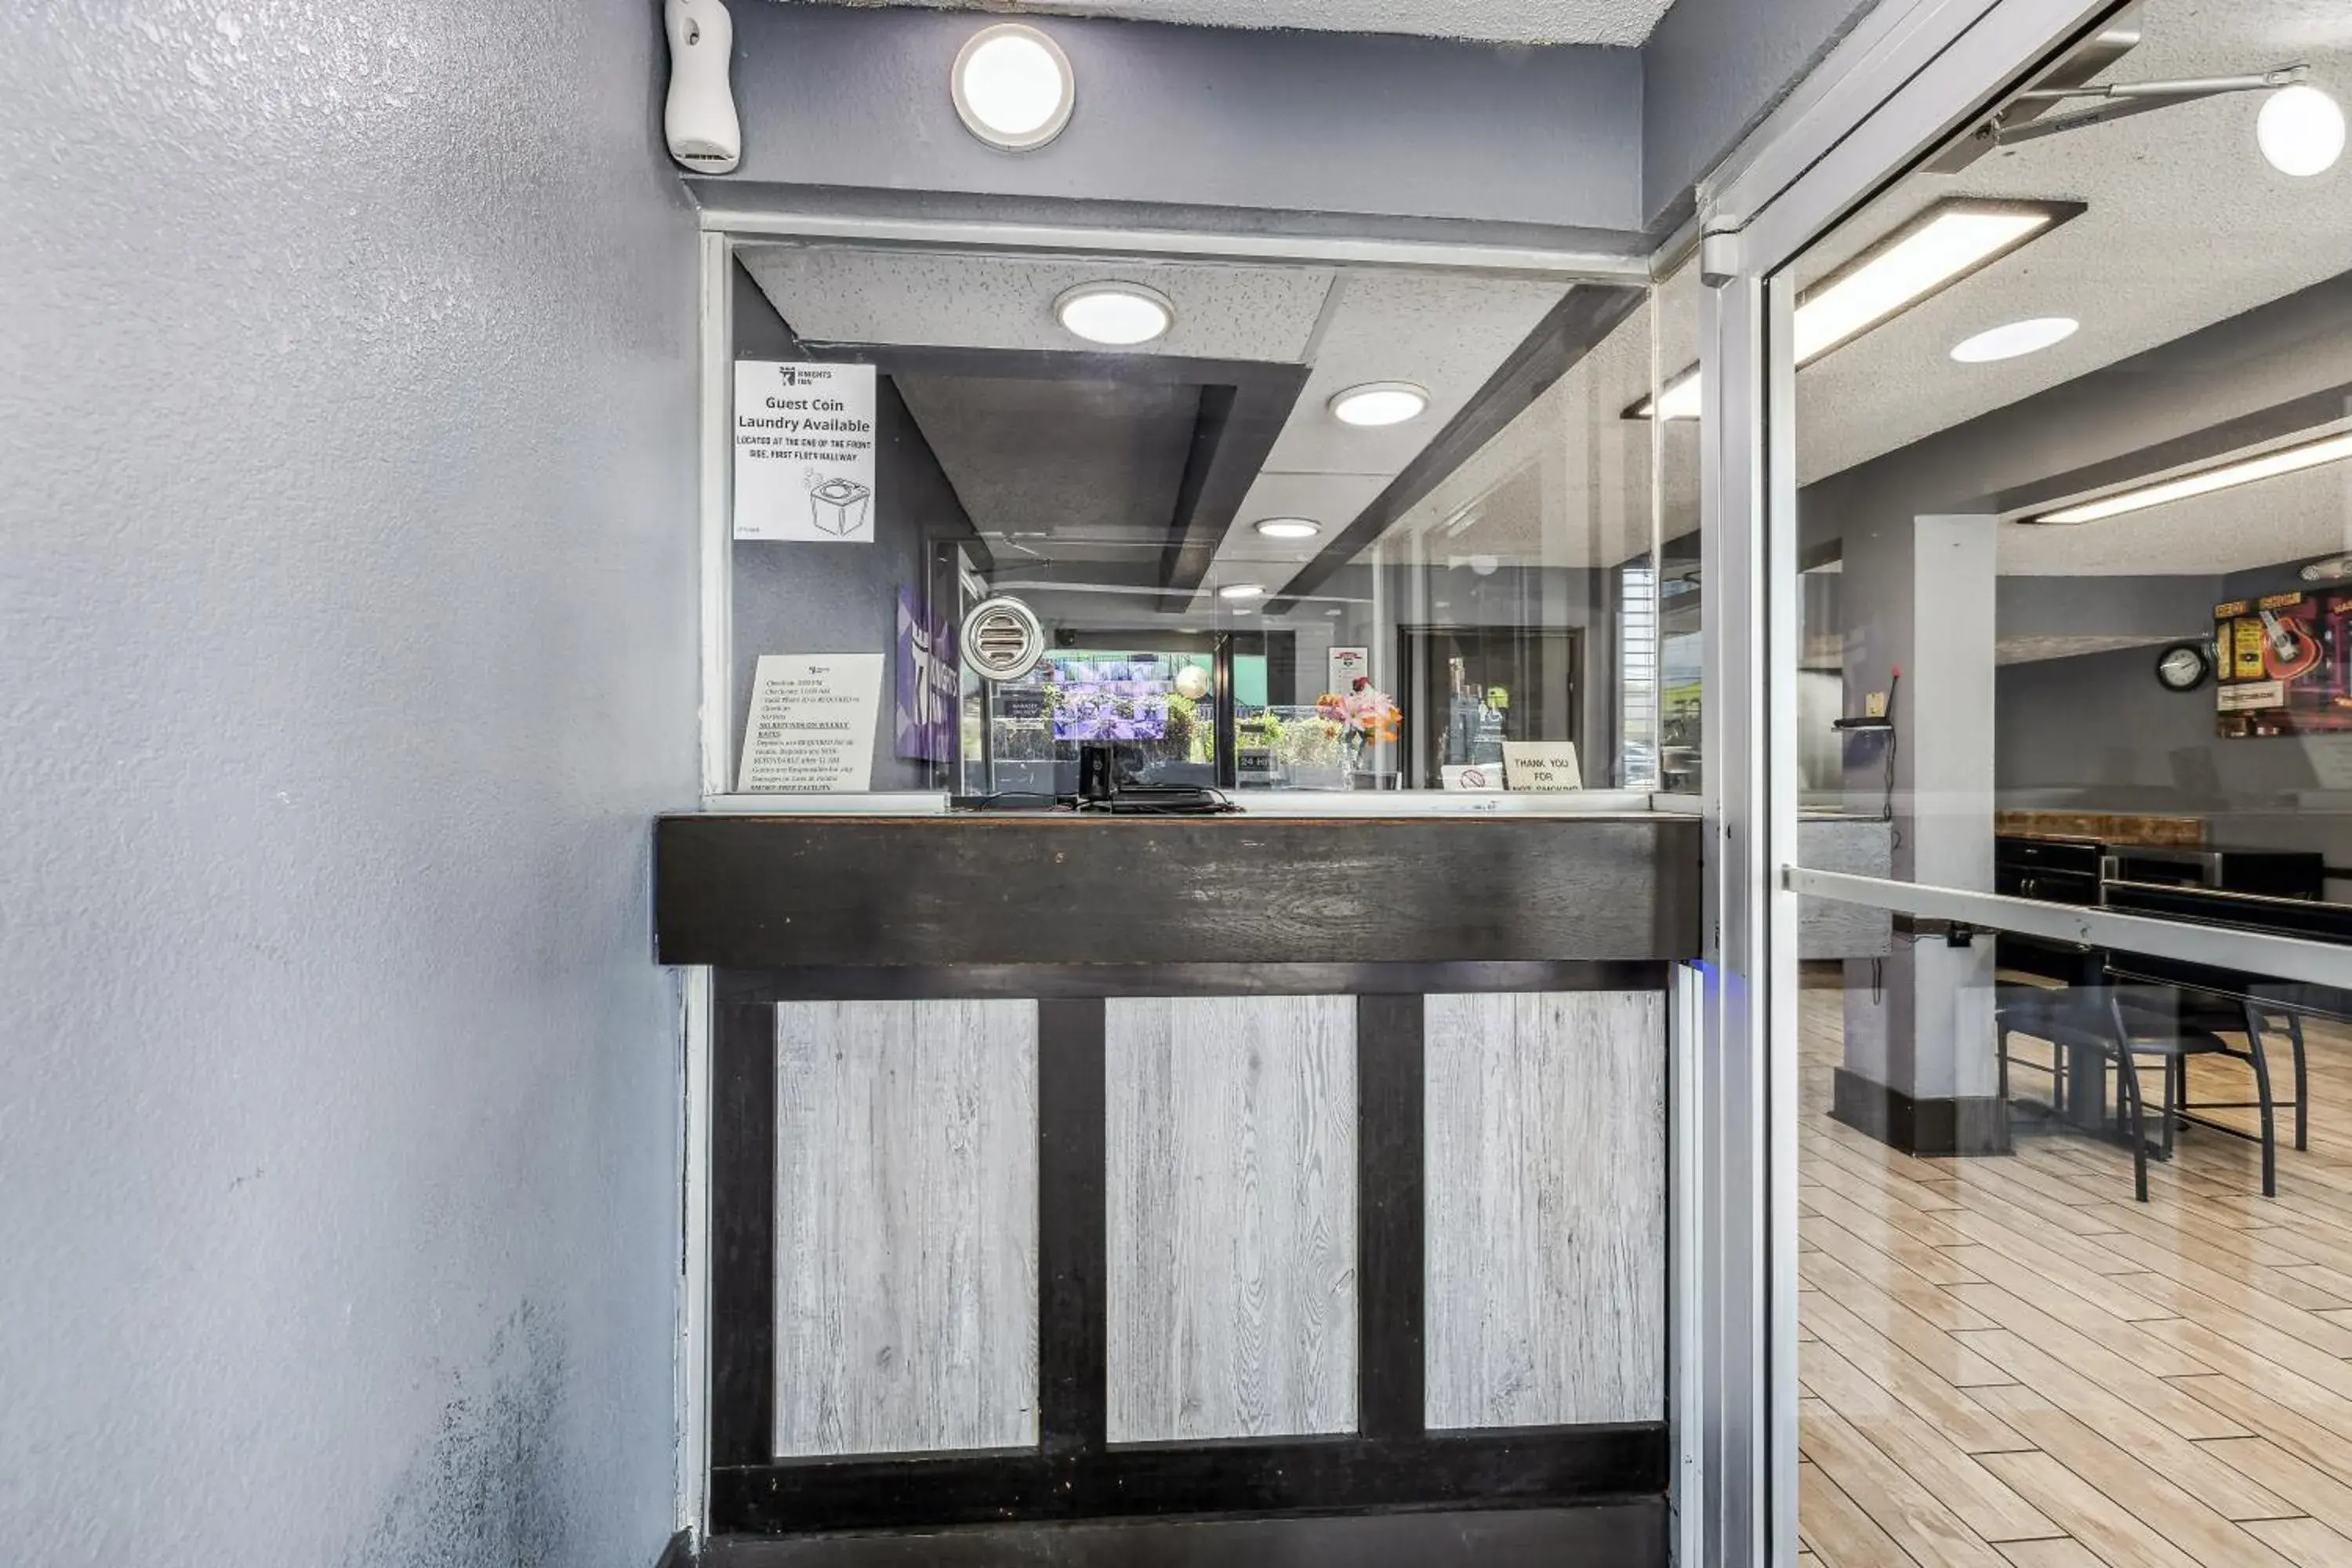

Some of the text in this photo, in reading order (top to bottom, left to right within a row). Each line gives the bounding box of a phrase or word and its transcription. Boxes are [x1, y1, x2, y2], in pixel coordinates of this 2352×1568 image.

[765, 397, 844, 412] Guest Coin
[739, 416, 870, 432] Laundry Available
[737, 436, 771, 445] LOCATED
[772, 437, 782, 445] AT
[785, 437, 798, 446] THE
[801, 438, 816, 447] END
[830, 440, 844, 448] THE
[846, 441, 871, 449] FRONT
[771, 450, 792, 459] FIRST
[1515, 758, 1569, 768] THANK YOU
[1534, 772, 1553, 781] FOR
